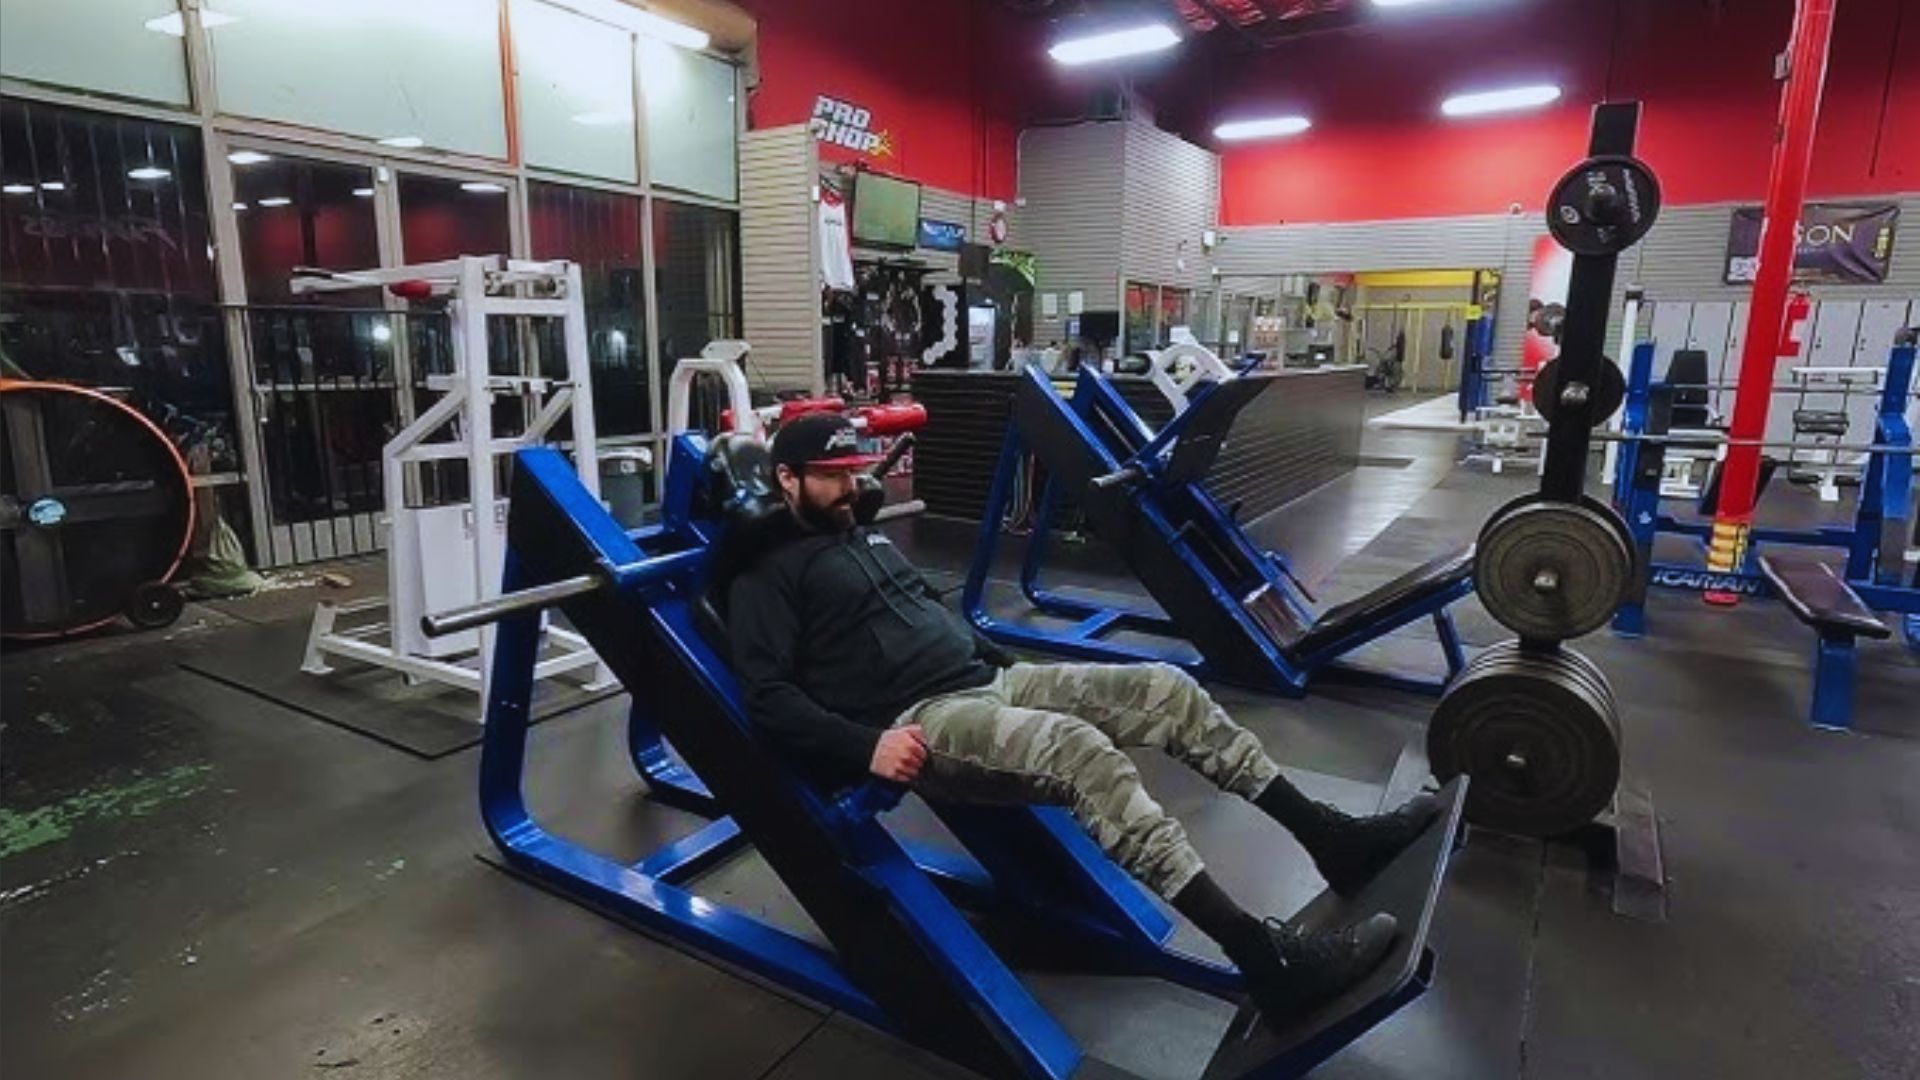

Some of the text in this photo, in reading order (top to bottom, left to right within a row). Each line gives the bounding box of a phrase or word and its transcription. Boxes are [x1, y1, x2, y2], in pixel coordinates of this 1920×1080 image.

[813, 94, 871, 129] PRO
[809, 117, 880, 152] SHOP
[1652, 569, 1758, 593] ICARIAN
